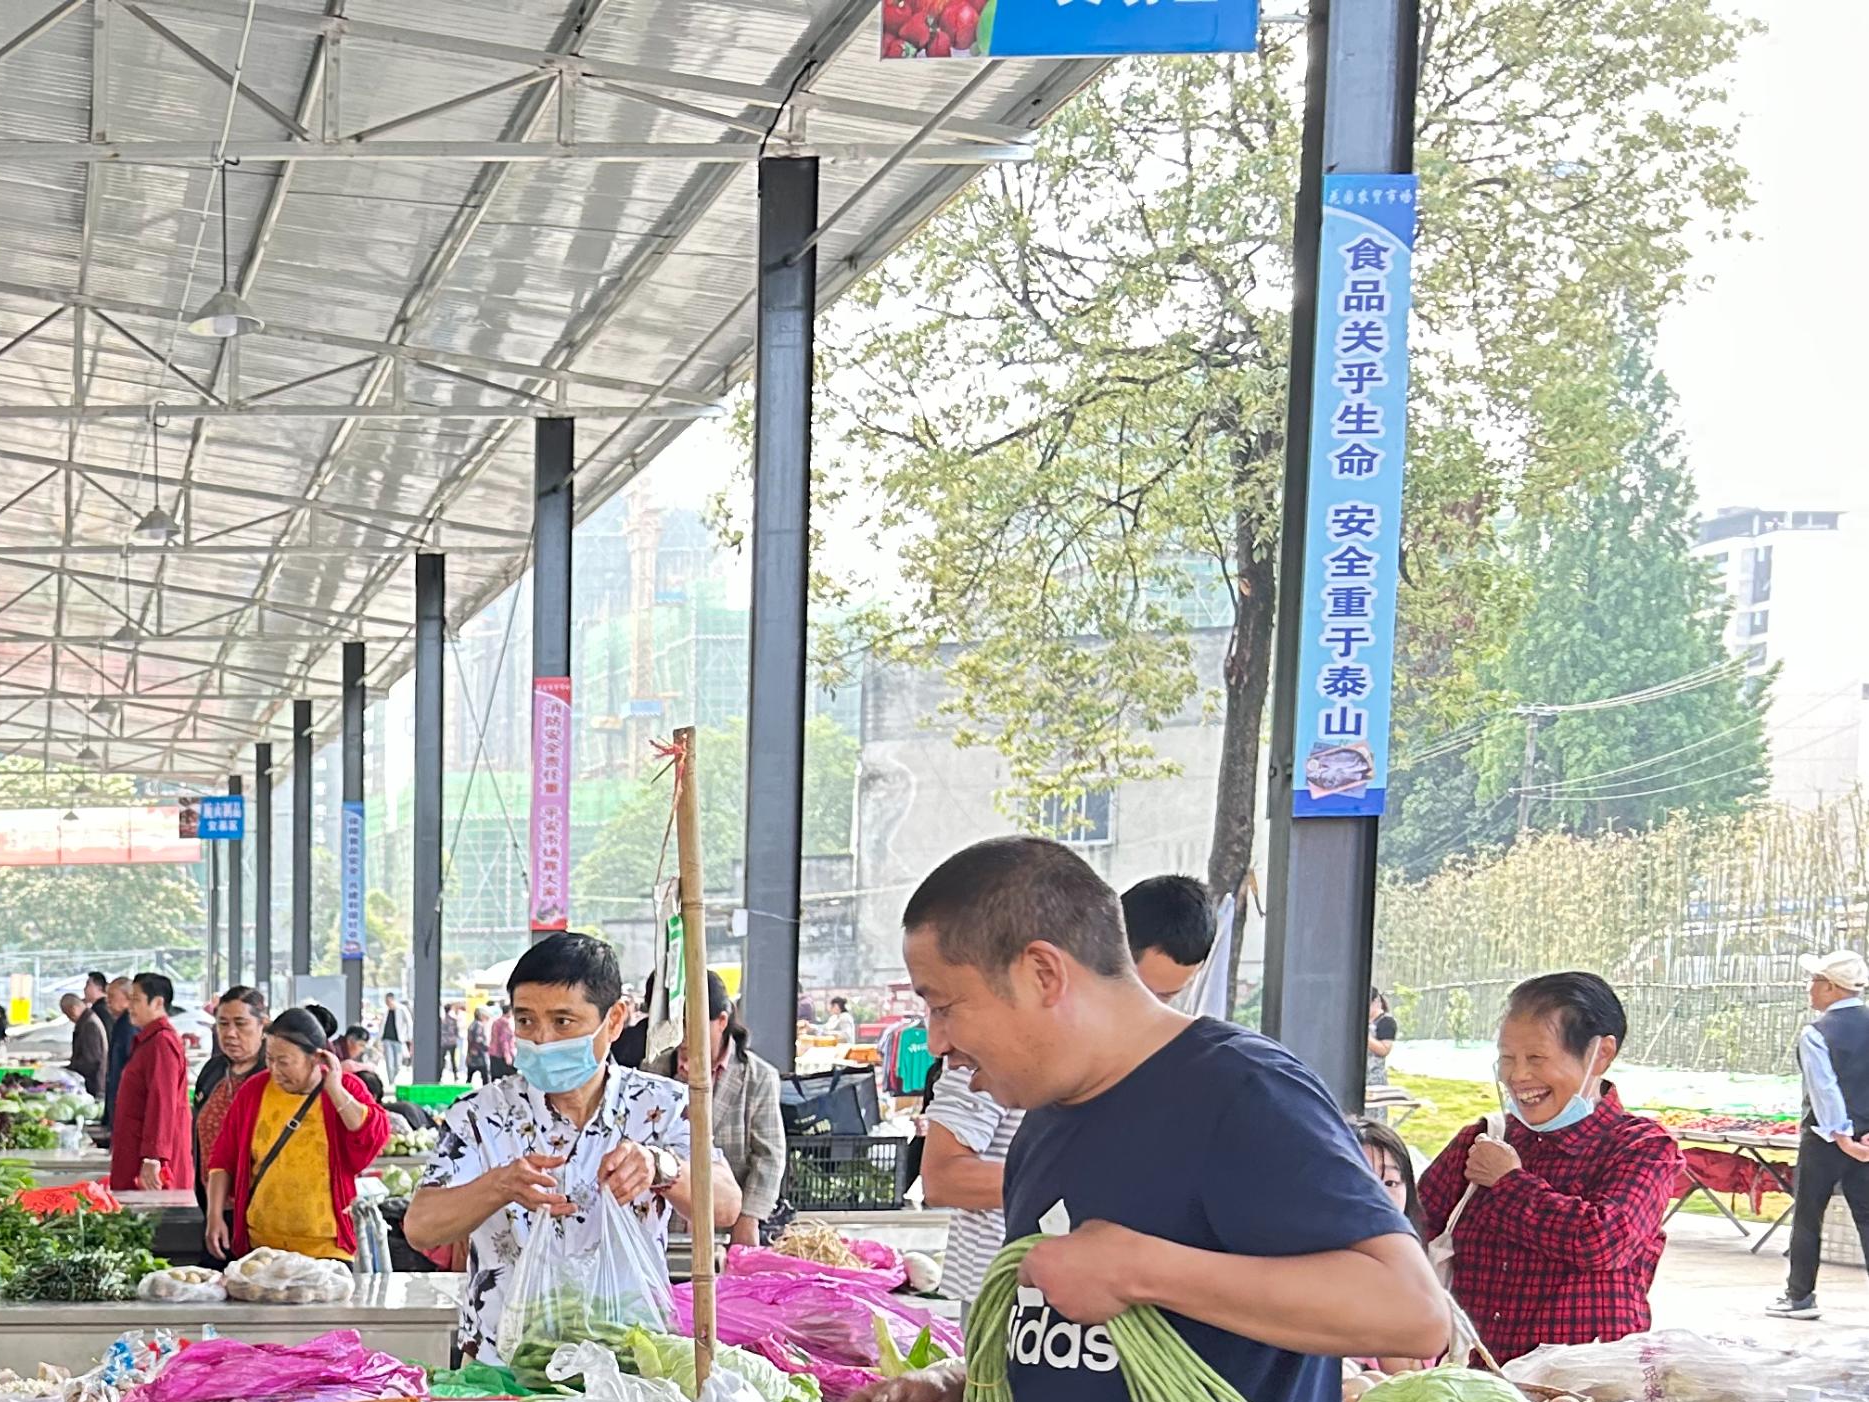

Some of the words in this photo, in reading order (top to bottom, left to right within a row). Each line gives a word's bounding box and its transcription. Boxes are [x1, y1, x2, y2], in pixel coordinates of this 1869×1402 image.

[1333, 237, 1390, 477] 食品关乎生命
[1323, 504, 1376, 737] 安全重于泰山
[1007, 1304, 1121, 1372] idas
